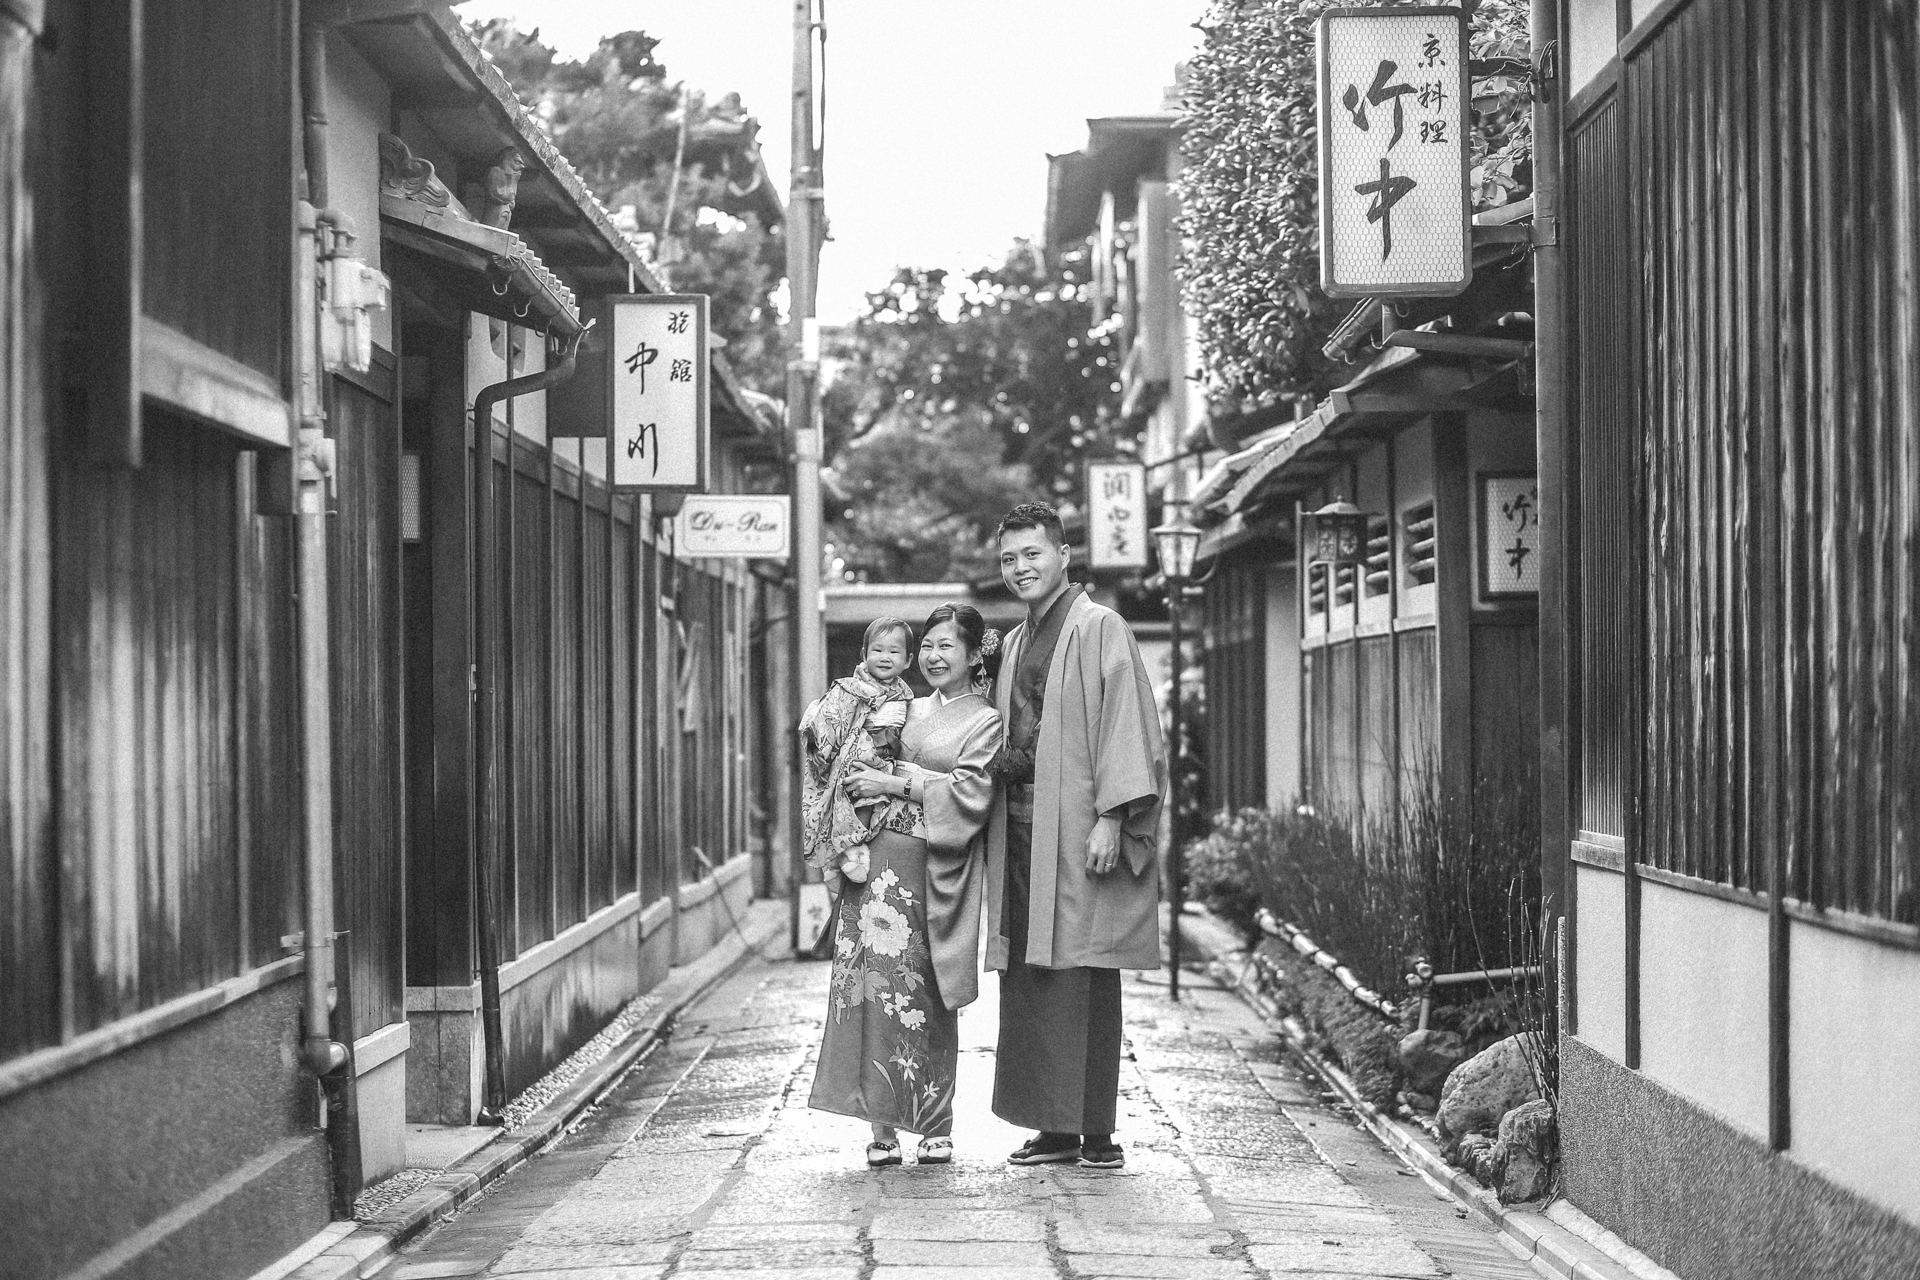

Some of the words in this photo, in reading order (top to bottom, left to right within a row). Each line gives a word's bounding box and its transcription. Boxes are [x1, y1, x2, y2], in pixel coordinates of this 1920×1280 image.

[1418, 33, 1448, 144] 京料理
[1342, 59, 1419, 263] 竹中
[1502, 493, 1532, 580] 竹中
